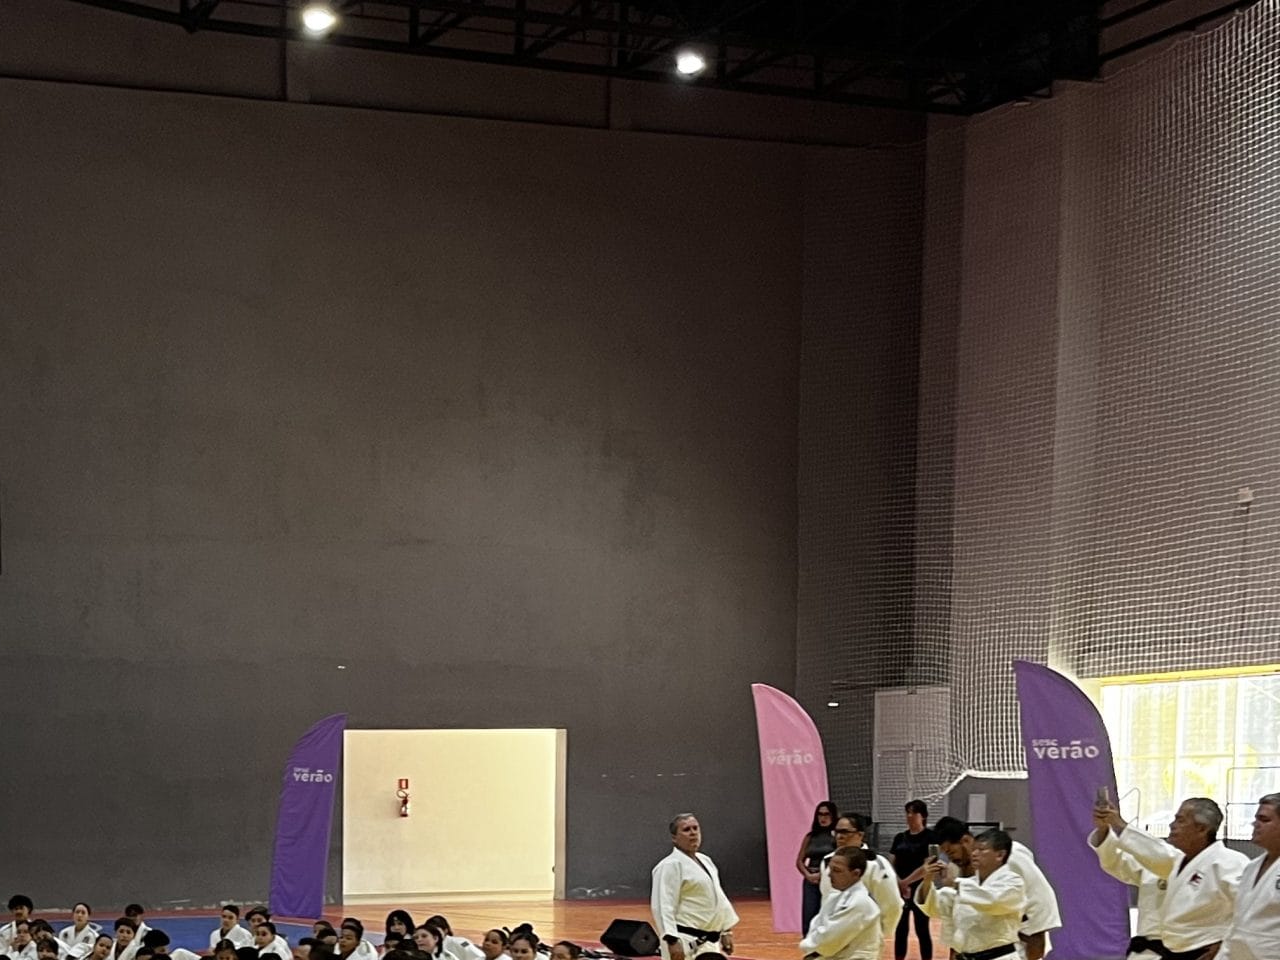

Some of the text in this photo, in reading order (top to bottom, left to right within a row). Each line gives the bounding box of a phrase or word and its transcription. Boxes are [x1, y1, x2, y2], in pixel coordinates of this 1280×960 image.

[767, 749, 814, 766] verão
[1032, 740, 1100, 760] verão
[293, 769, 333, 783] verão
